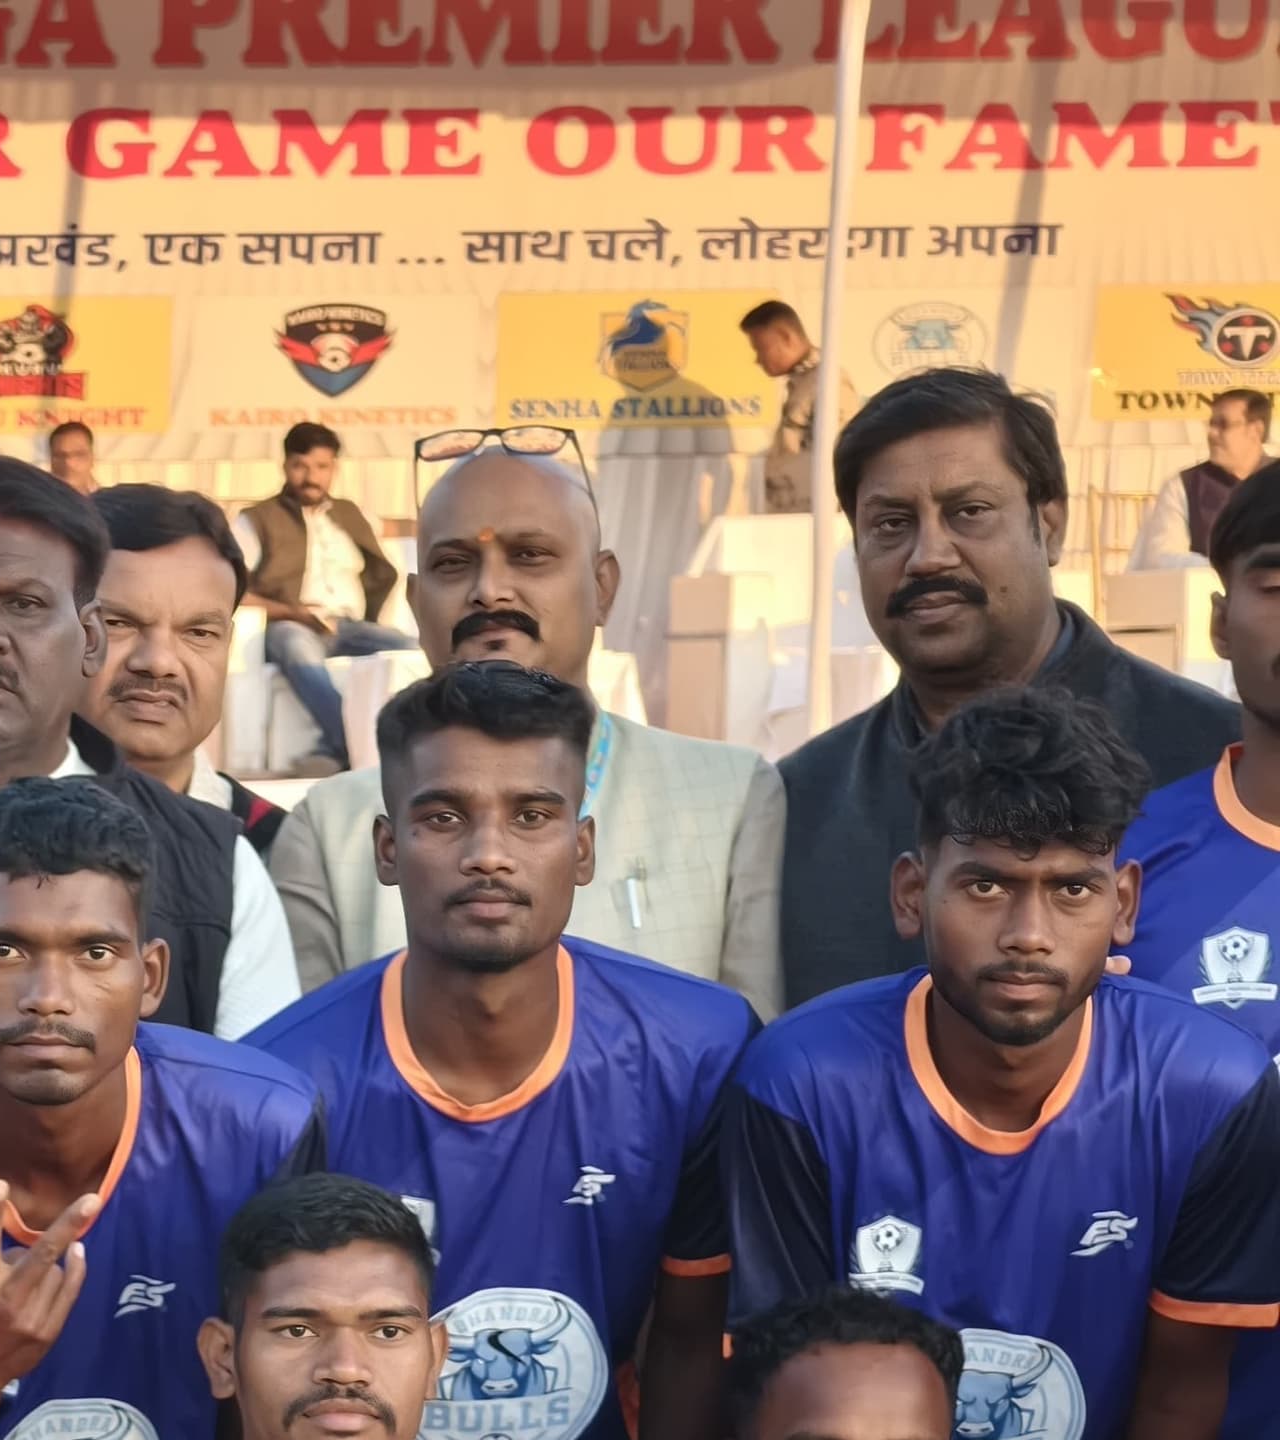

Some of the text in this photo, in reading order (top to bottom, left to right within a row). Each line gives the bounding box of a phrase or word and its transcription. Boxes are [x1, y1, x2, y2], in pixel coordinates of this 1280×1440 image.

[151, 0, 797, 68] PREMIER
[815, 0, 1280, 64] LEAGU
[67, 107, 484, 181] GAME
[525, 105, 826, 177] OUR
[142, 232, 228, 267] एक
[236, 230, 383, 266] सपना
[461, 229, 573, 264] साथ
[926, 223, 1065, 258] अपना
[316, 405, 459, 427] KINETICS
[510, 397, 761, 420] SENHA STALLIONS
[423, 1394, 574, 1433] BULLS
